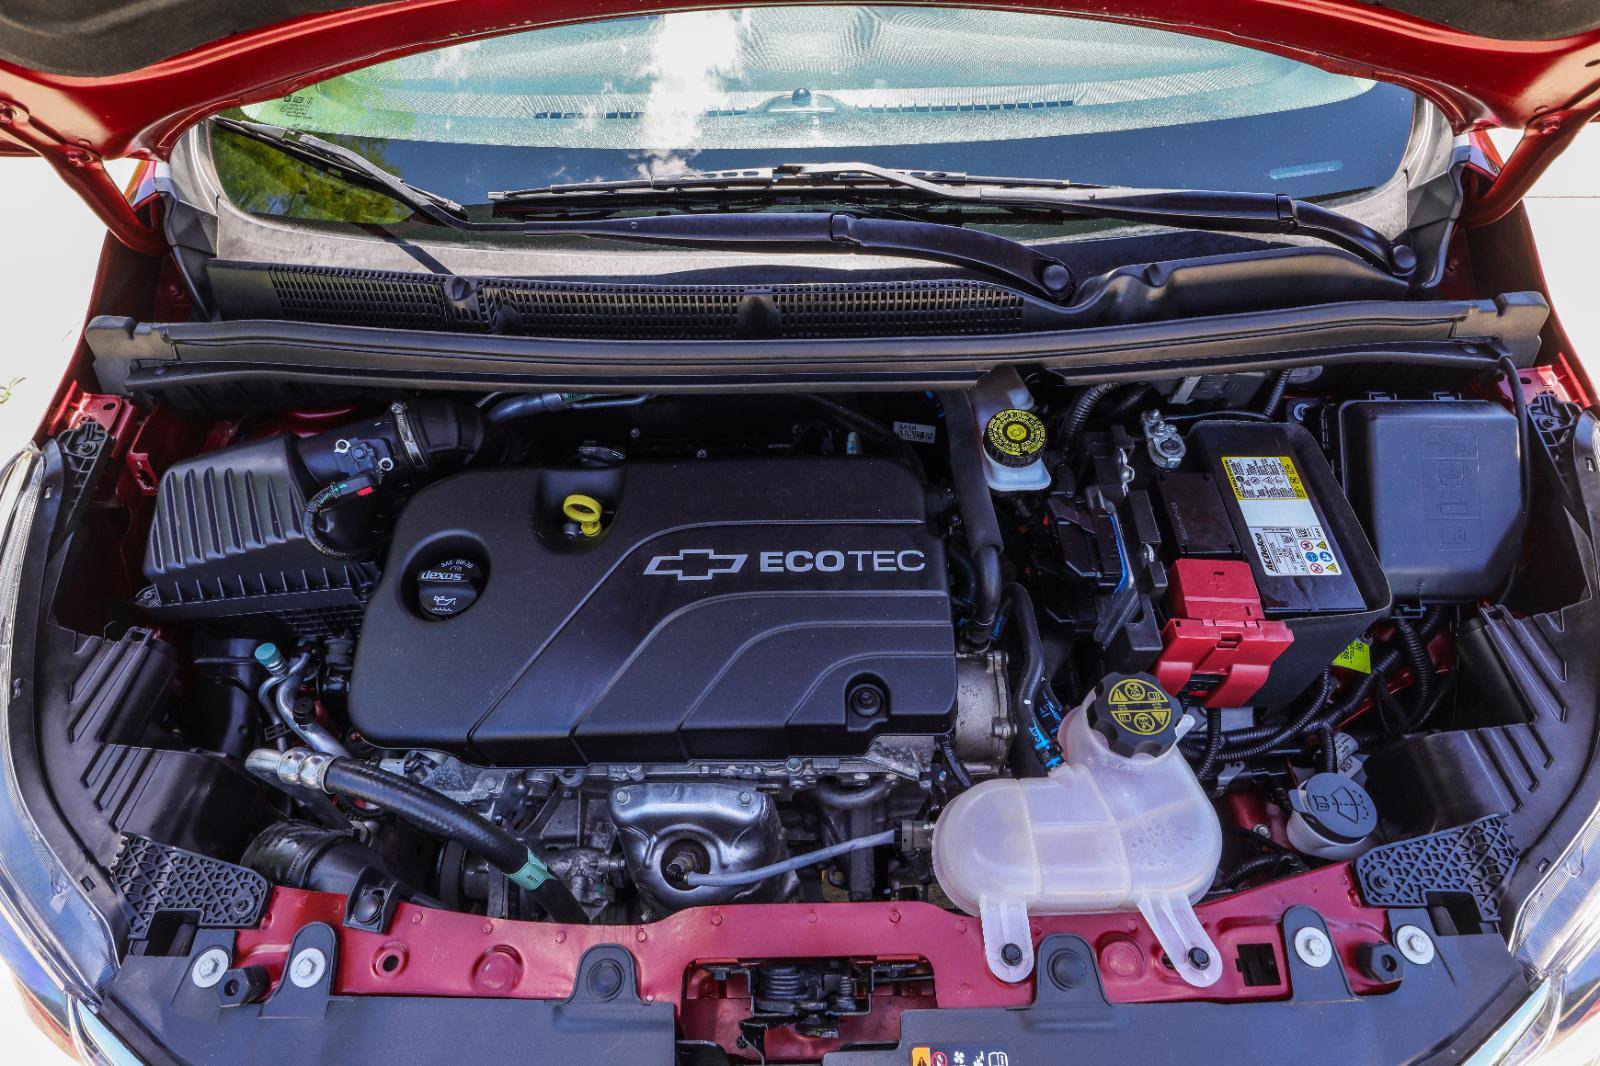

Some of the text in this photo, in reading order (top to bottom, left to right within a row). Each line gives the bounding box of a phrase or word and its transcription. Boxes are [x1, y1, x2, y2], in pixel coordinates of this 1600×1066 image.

[759, 550, 926, 572] ECOTEC
[1255, 533, 1275, 572] ACDelco
[420, 570, 463, 581] dexos
